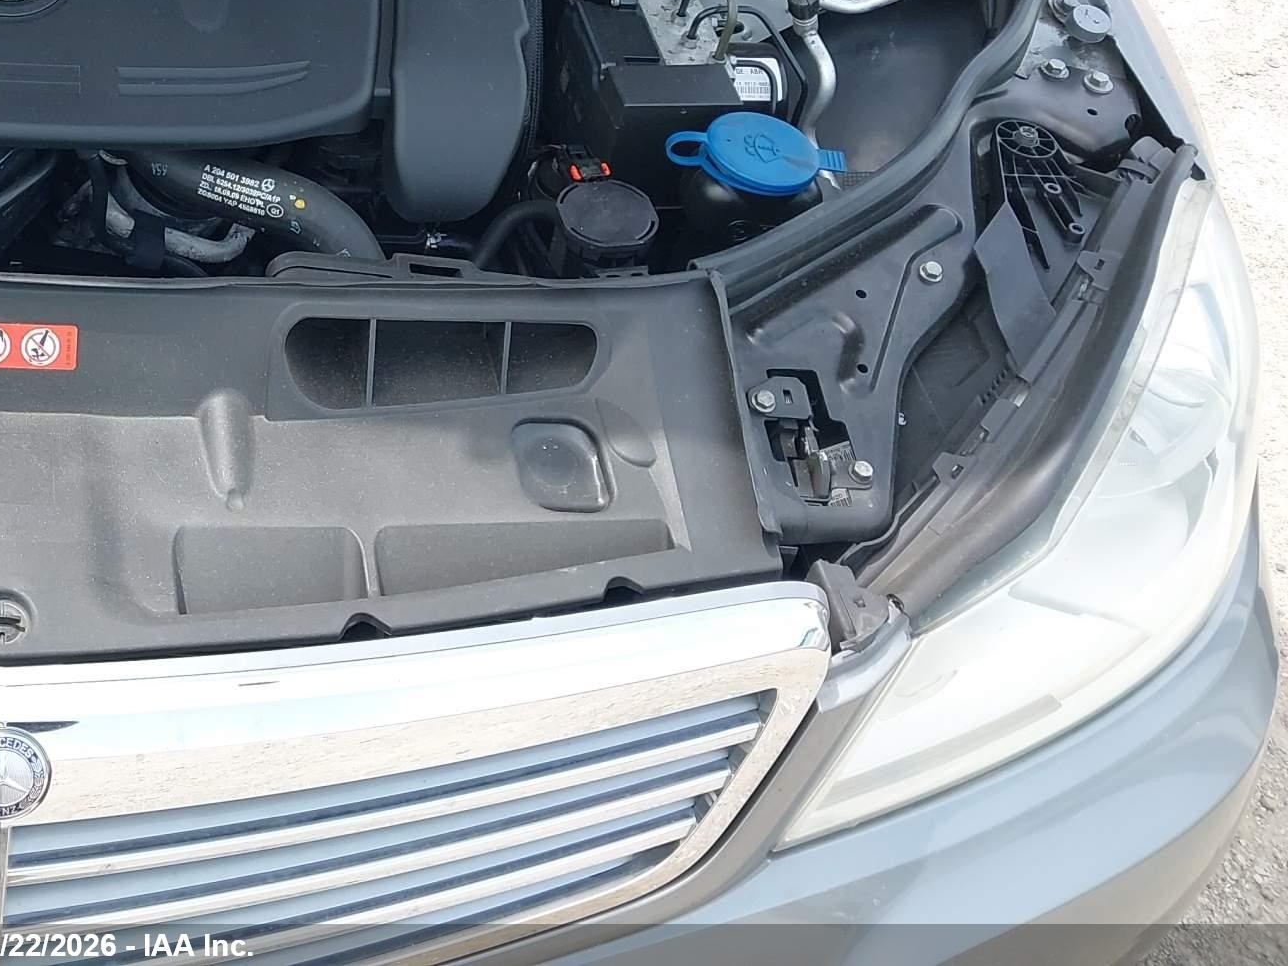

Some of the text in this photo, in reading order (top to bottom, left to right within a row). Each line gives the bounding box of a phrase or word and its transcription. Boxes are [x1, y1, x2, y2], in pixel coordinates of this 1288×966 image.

[204, 164, 210, 173] A
[211, 166, 225, 177] 204
[225, 171, 240, 182] 501
